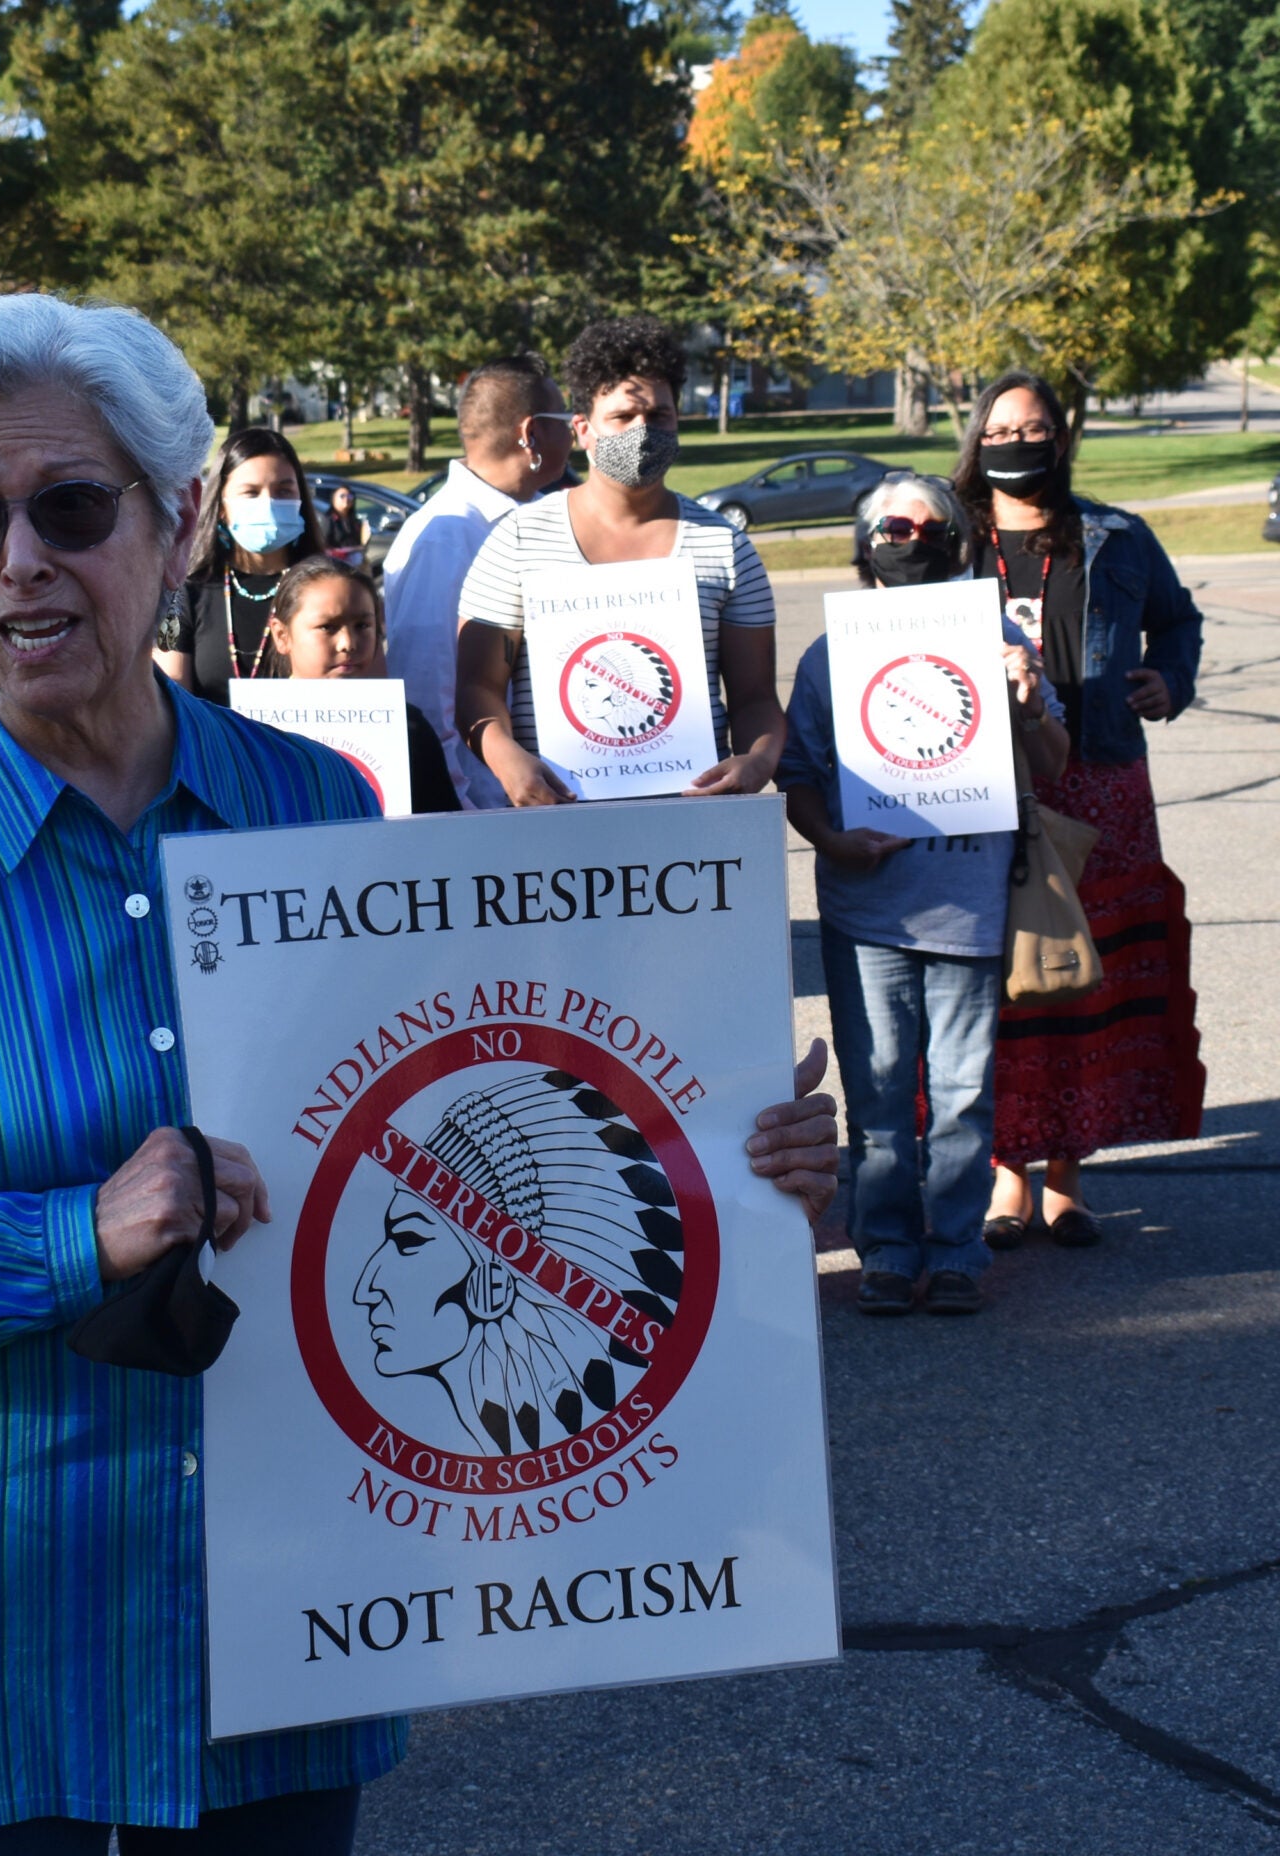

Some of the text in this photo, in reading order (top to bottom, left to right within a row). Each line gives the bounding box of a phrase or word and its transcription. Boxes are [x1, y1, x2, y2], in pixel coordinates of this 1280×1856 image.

[538, 588, 683, 614] TEACH RESPECT
[606, 631, 624, 641] NO
[579, 657, 670, 714] STEREOTYPES
[246, 709, 395, 724] TEACH RESPECT
[580, 732, 675, 758] NOT MASCOTS
[583, 723, 668, 746] IN OUR SCHOOLS
[341, 739, 384, 773] PEOPLE
[569, 759, 693, 780] NOT RACISM
[879, 756, 973, 782] NOT MASCOTS
[867, 786, 990, 811] NOT RACISM
[220, 877, 455, 948] TEACH
[471, 857, 743, 929] RESPECT
[471, 1029, 524, 1062] NO
[291, 980, 707, 1150] INDIANS ARE PEOPLE
[371, 1128, 664, 1355] STEREOTYPES
[363, 1393, 654, 1491] IN OUR SCHOOLS
[347, 1432, 680, 1542] NOT MASCOTS
[301, 1556, 742, 1664] NOT RACISM
